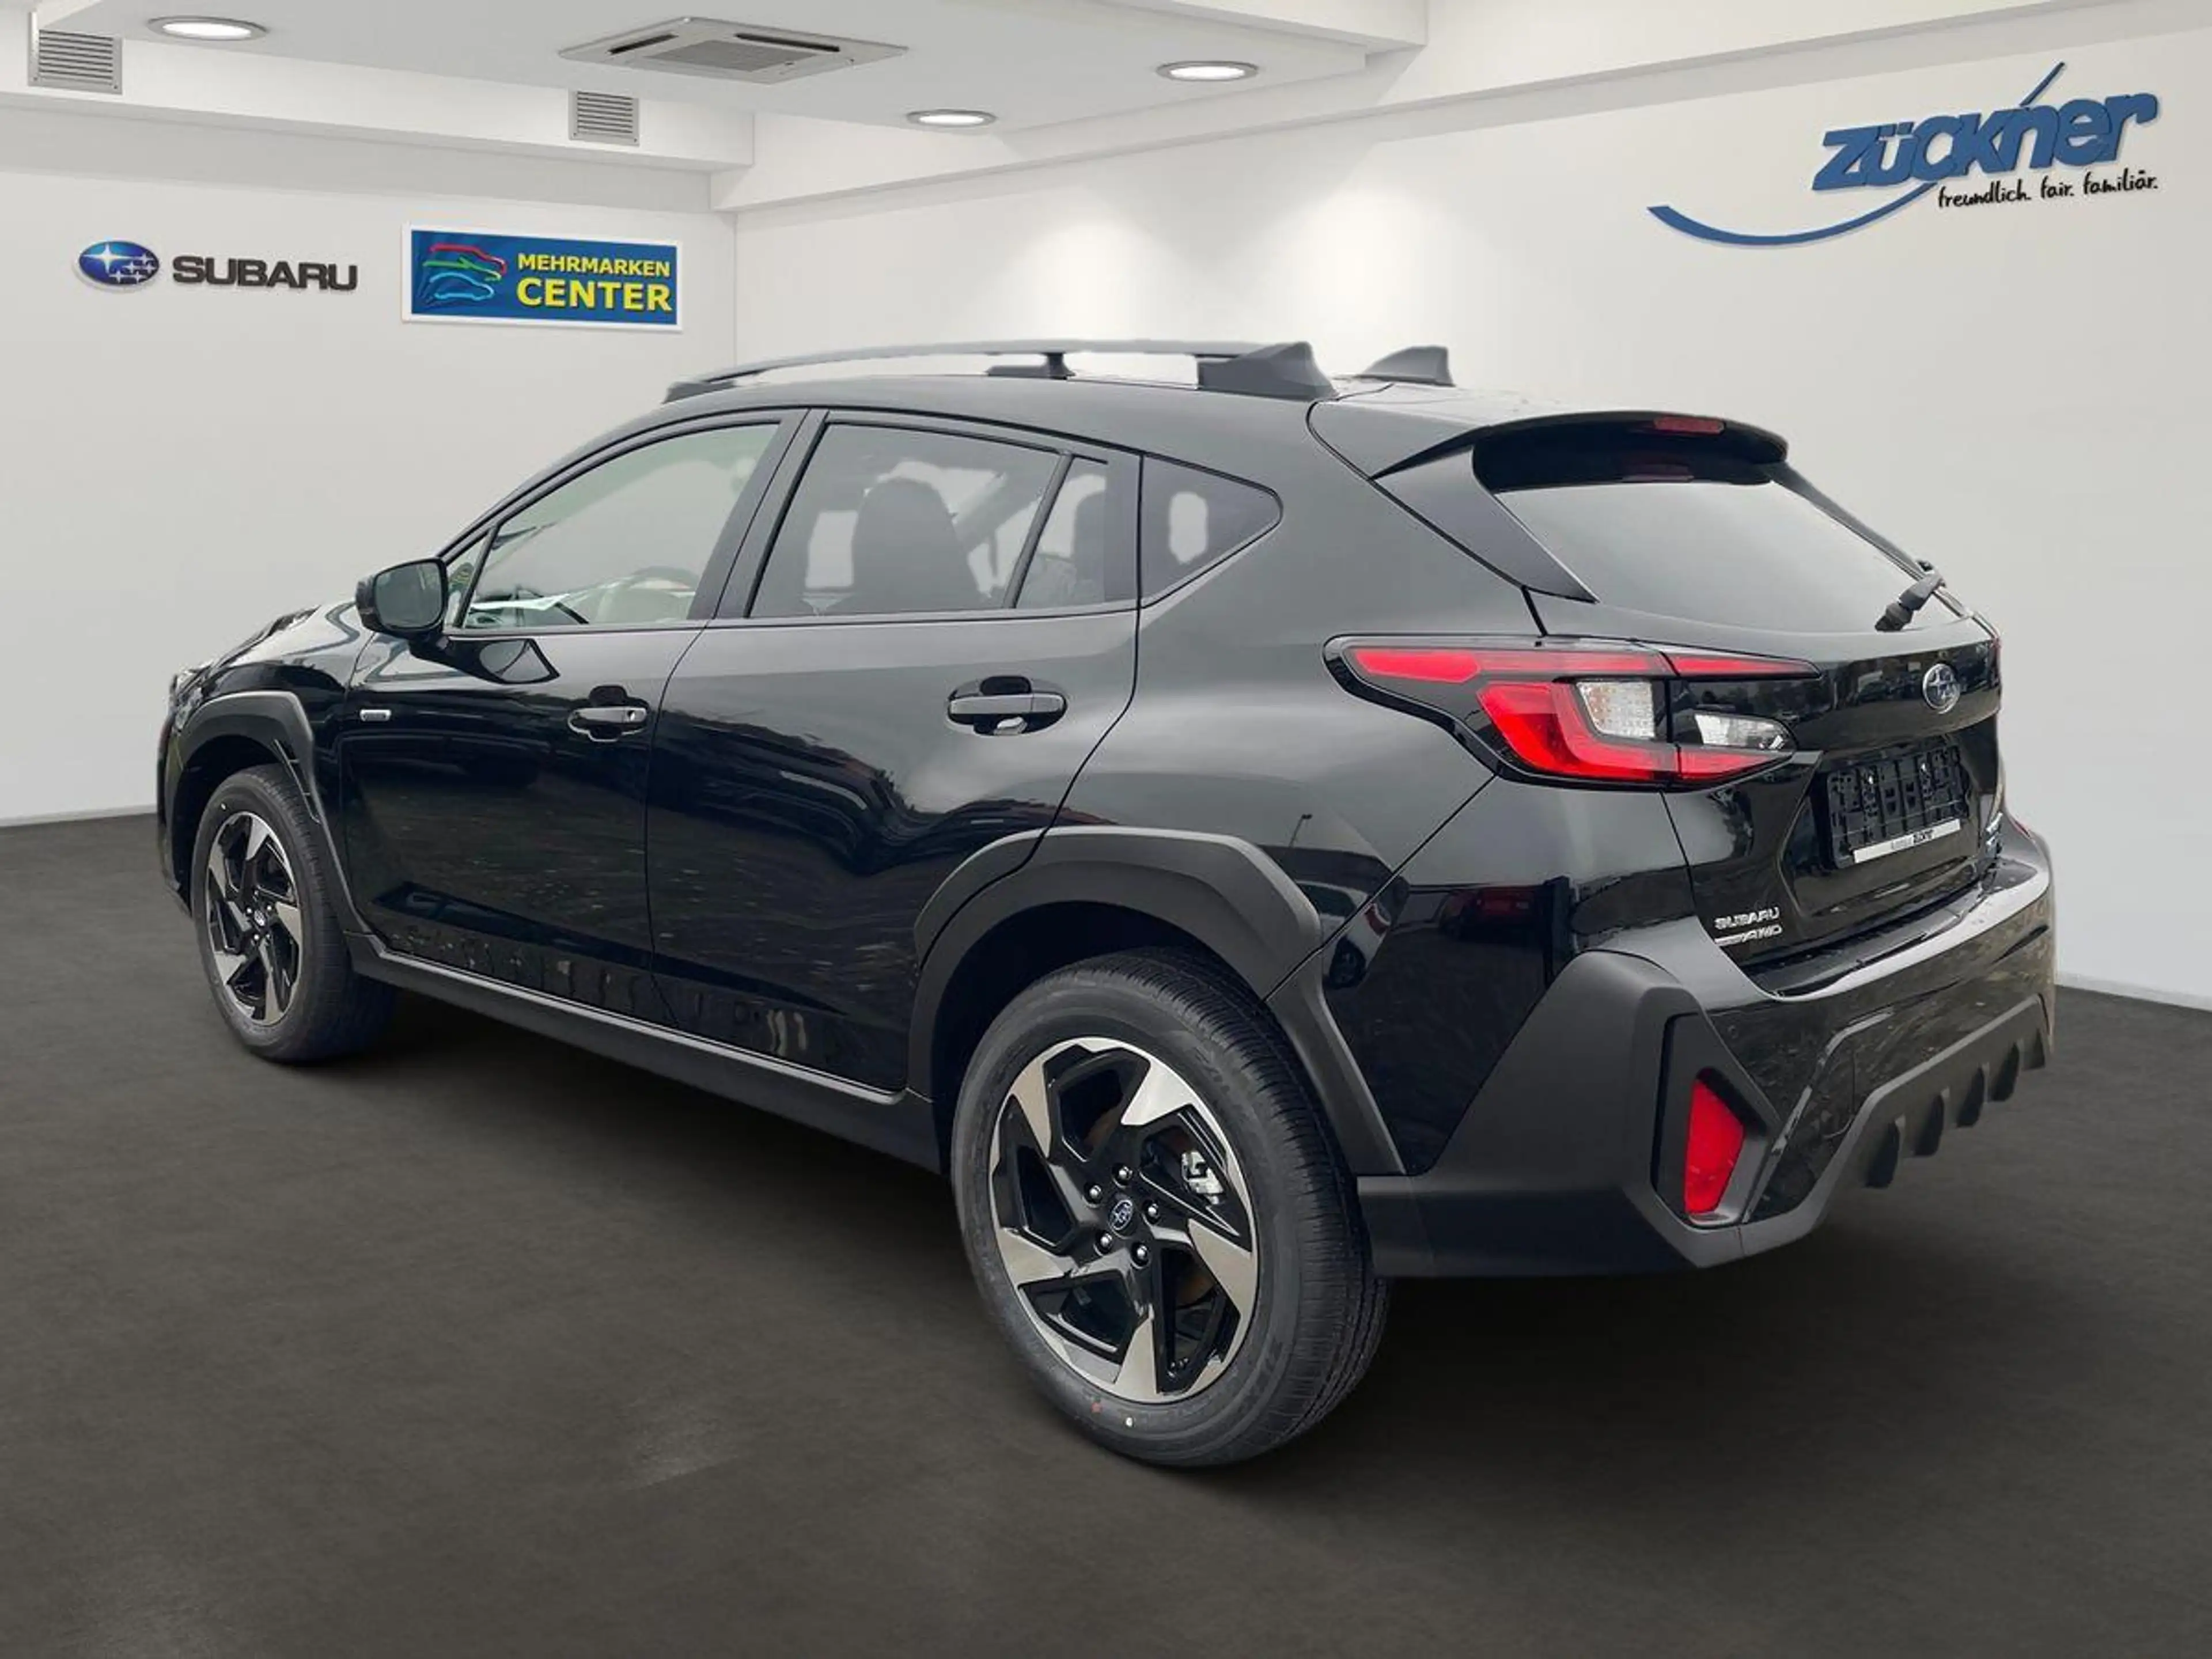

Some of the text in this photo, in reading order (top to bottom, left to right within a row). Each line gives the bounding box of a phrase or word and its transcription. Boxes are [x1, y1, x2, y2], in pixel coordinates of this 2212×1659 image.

[2040, 175, 2074, 199] fair.
[173, 255, 357, 291] SUBARU
[518, 253, 670, 277] MEHRMARKEN
[516, 277, 672, 311] CENTER
[1714, 906, 1779, 930] SUBARU
